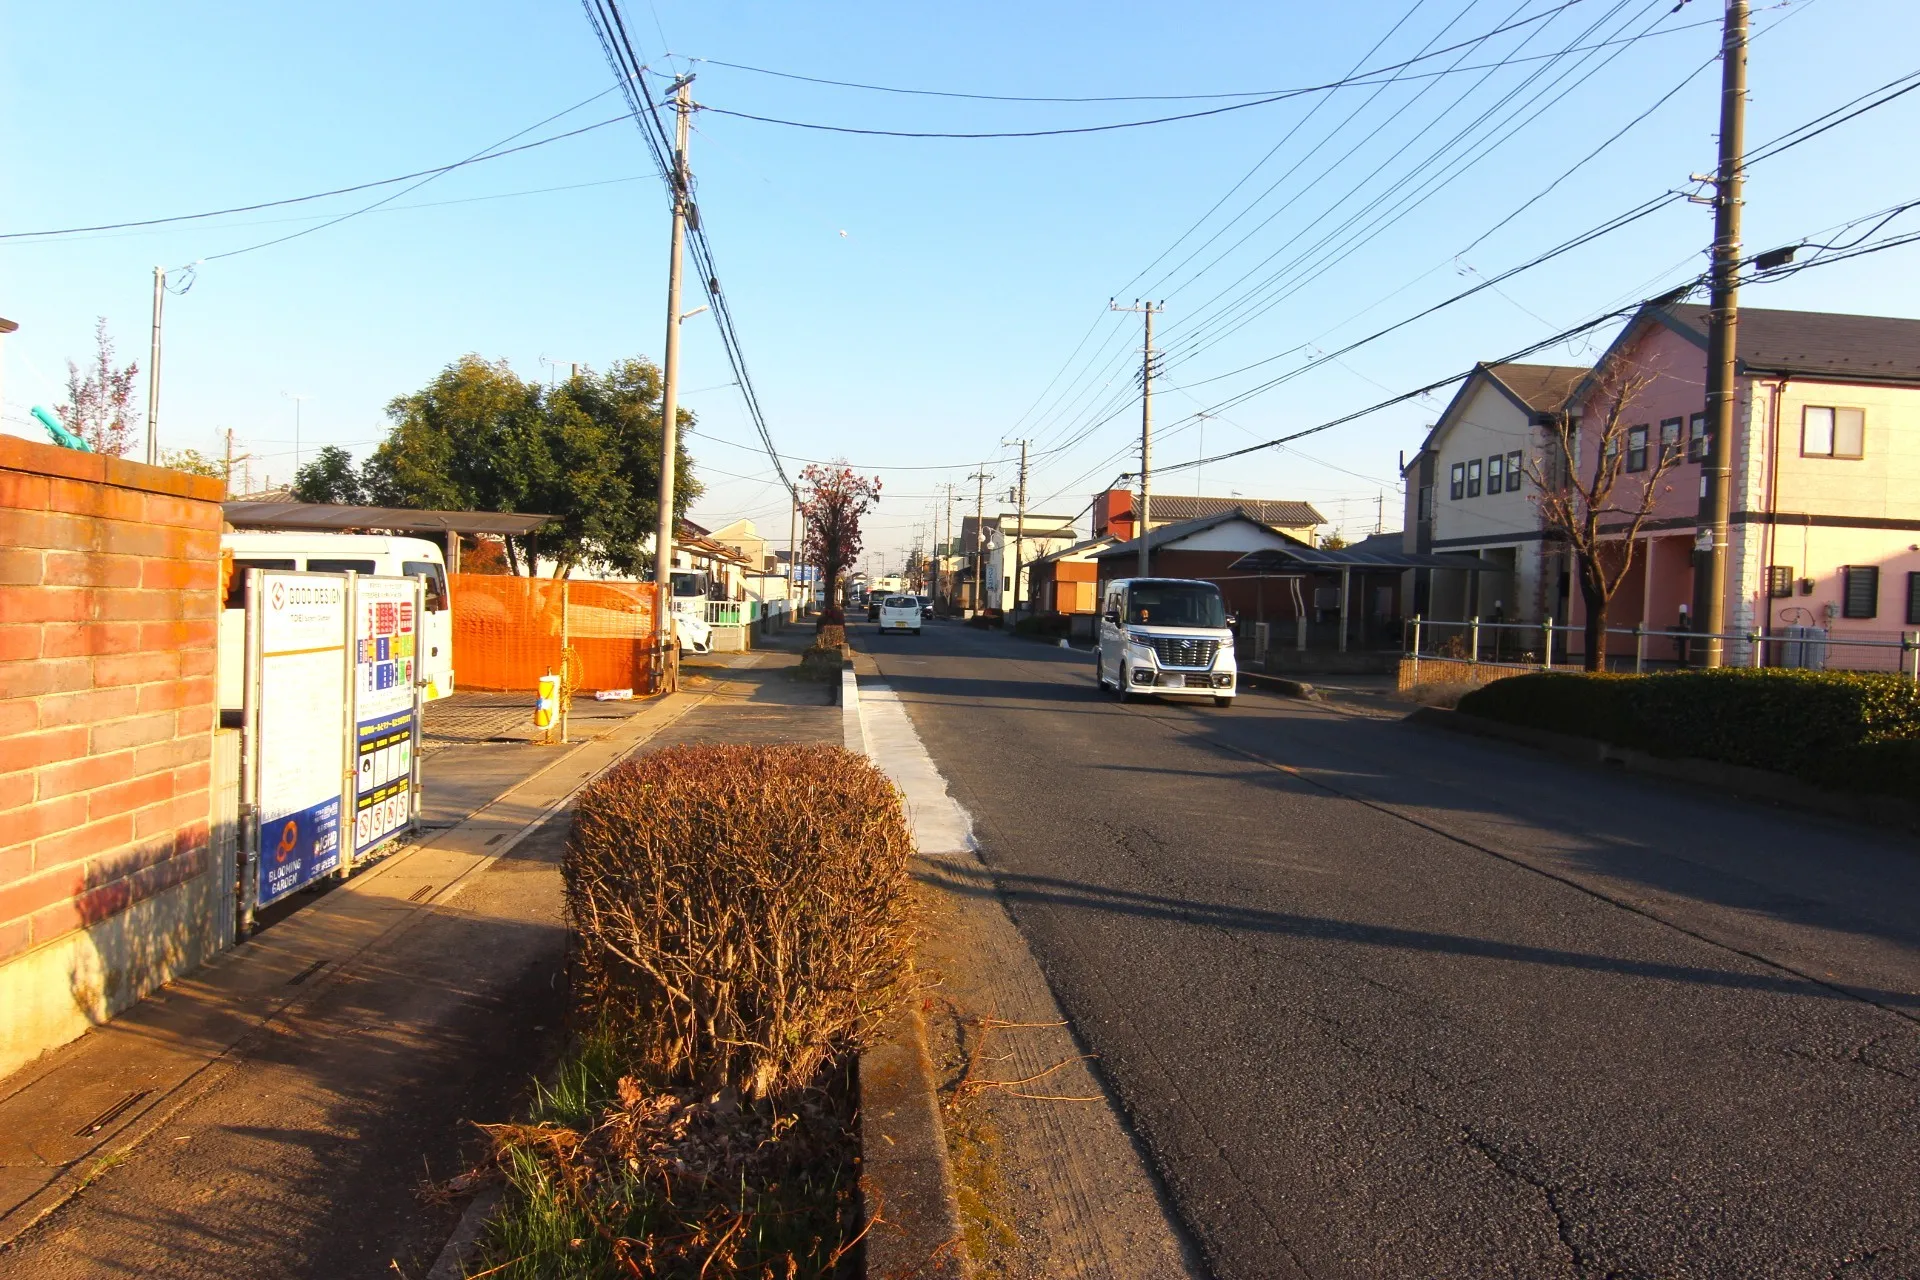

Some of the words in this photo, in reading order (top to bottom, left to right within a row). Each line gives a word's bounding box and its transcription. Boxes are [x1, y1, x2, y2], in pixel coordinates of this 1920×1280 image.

[290, 588, 311, 604] GOOD
[315, 588, 341, 604] DESIGN
[268, 858, 302, 883] BLOOMING
[271, 872, 298, 894] GARDEN
